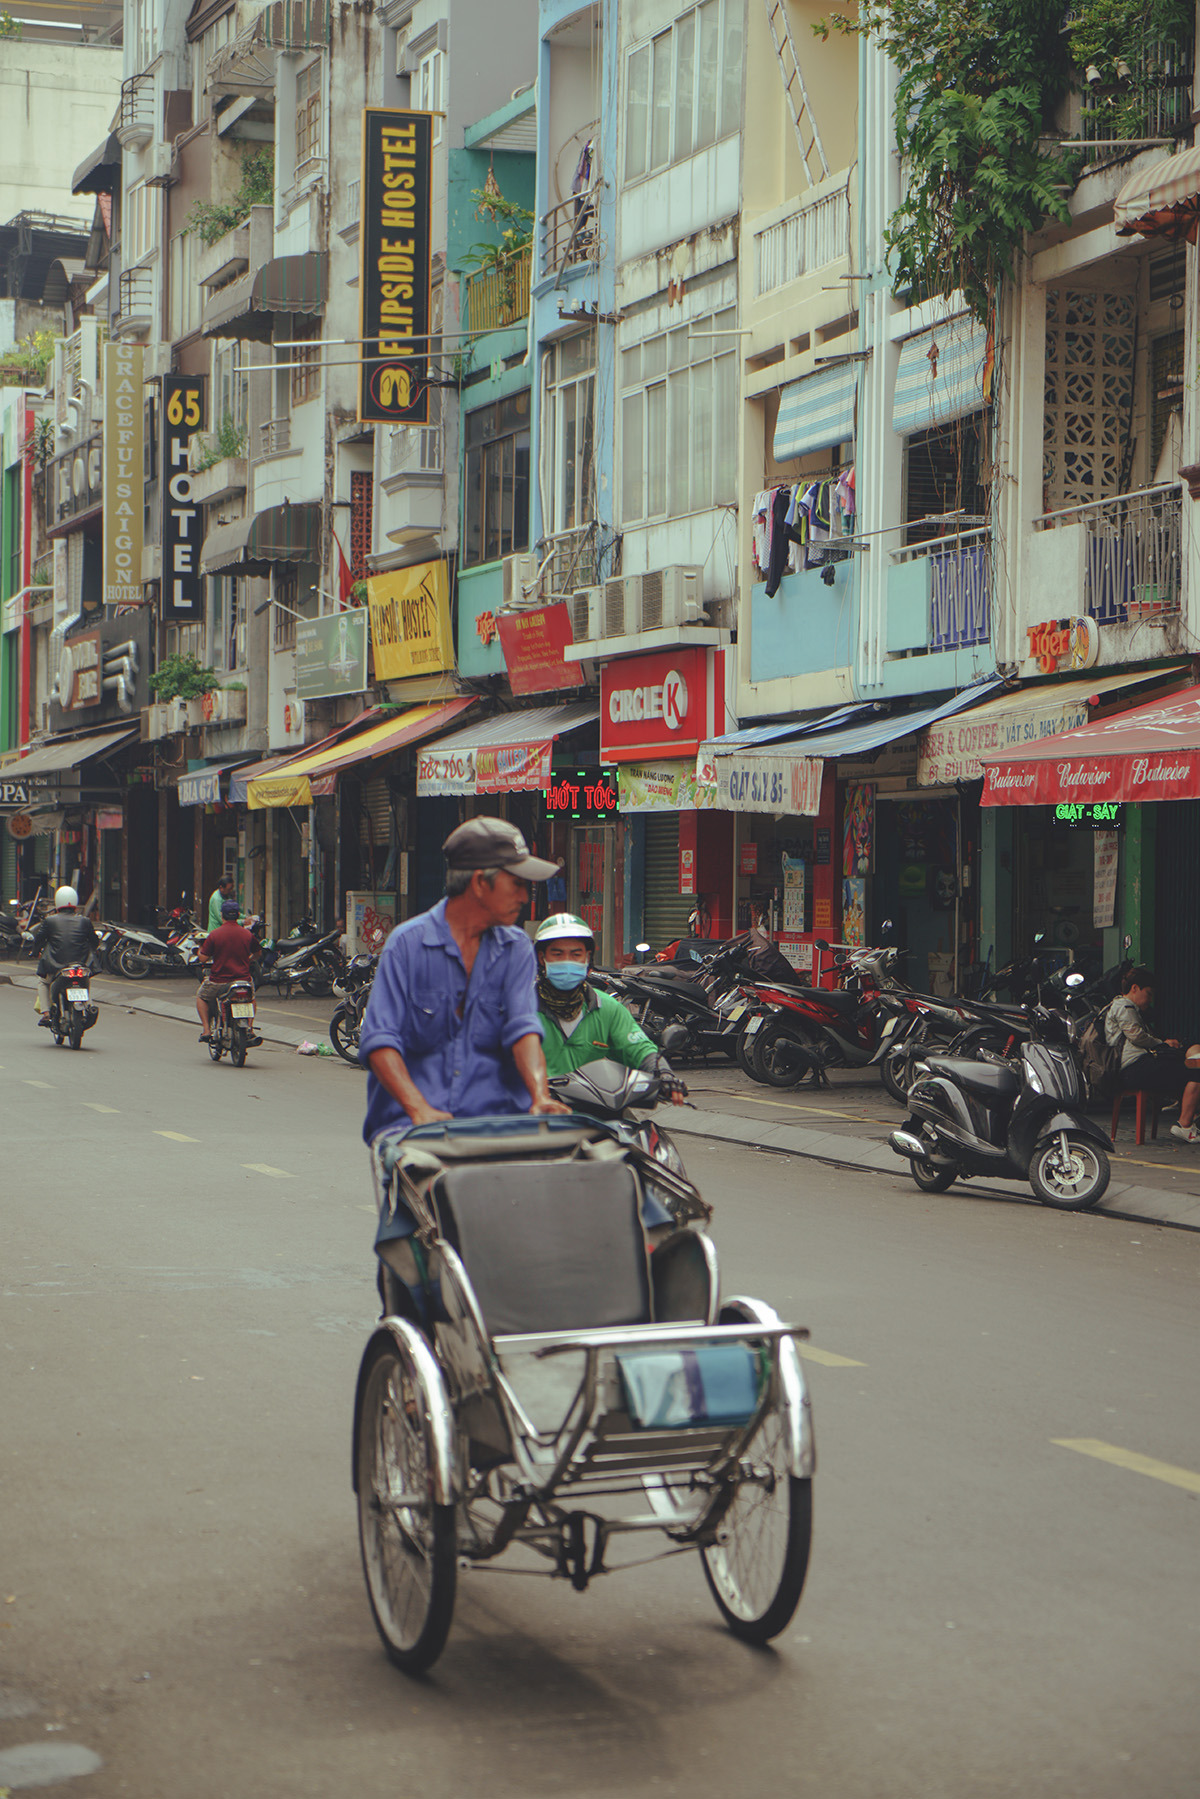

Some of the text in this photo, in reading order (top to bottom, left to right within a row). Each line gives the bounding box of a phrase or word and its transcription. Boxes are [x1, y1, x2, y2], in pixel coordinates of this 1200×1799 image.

[378, 123, 416, 355] FLIPSIDE HOSTEL
[167, 389, 201, 427] 65
[168, 437, 198, 608] HOTEL
[107, 585, 142, 601] HOTEL
[401, 593, 432, 642] HOSTEL
[475, 611, 497, 646] Tiger
[1026, 619, 1071, 674] Tiger
[609, 684, 664, 724] CIRCLE
[919, 722, 1000, 760] BEER & COFFEE
[442, 753, 465, 779] TÓC
[496, 746, 528, 775] GALLERY
[928, 754, 984, 780] 87 BÙI VIỆ
[0, 784, 28, 802] PA
[181, 778, 198, 804] BIA
[546, 779, 616, 810] HỚT TÓC
